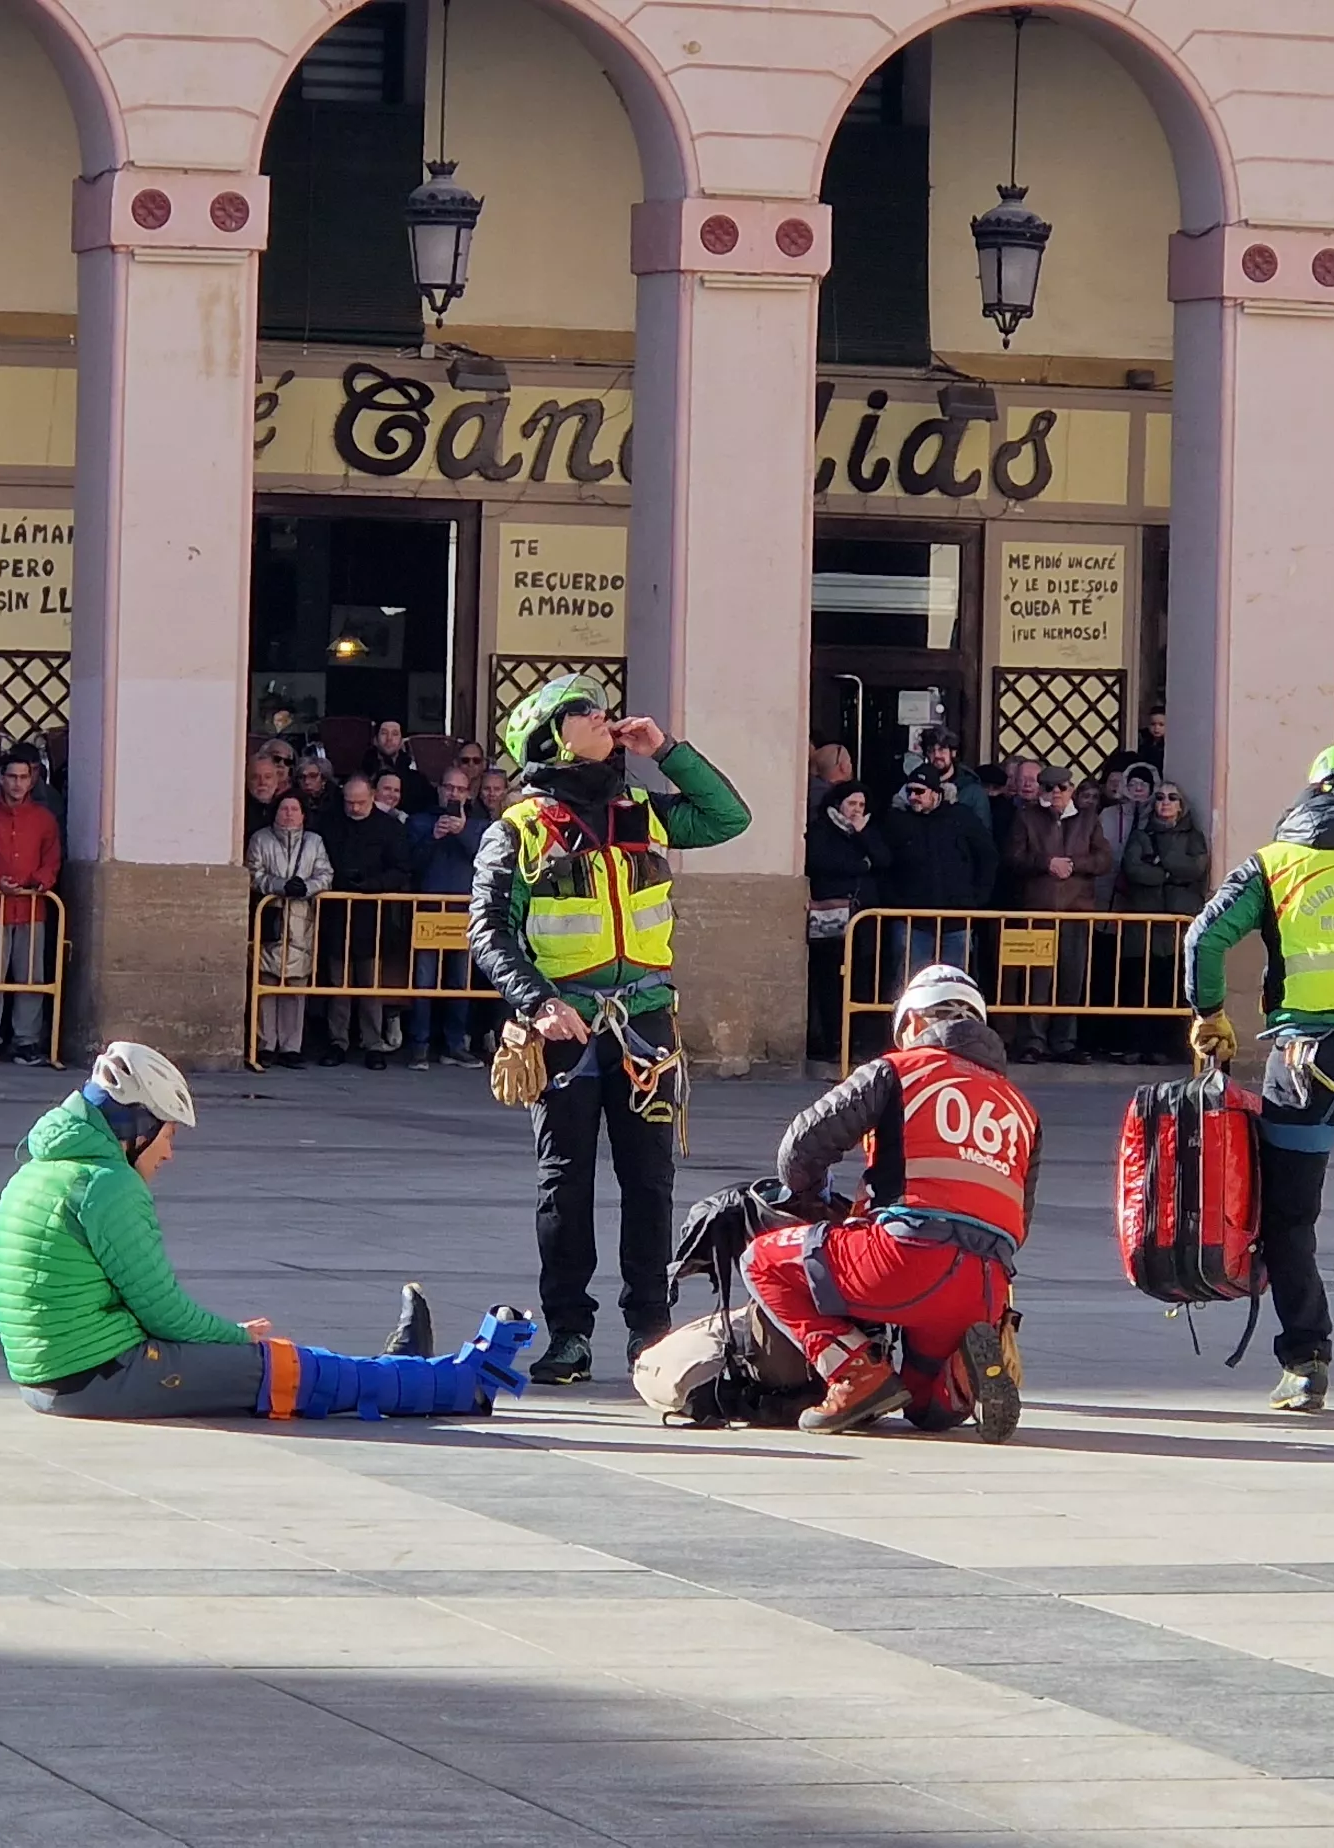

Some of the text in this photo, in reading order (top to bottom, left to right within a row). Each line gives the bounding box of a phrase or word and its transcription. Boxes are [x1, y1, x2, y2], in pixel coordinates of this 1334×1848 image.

[510, 538, 540, 559] TE
[1008, 553, 1031, 570] ME
[1034, 551, 1063, 570] PIDIÓ
[1084, 551, 1118, 570] CAFÉ
[514, 570, 625, 592] RECUERDO
[1009, 576, 1019, 593] Y
[1025, 577, 1039, 592] LE
[1043, 621, 1108, 641] HERMOSO!
[935, 1087, 1019, 1166] 061
